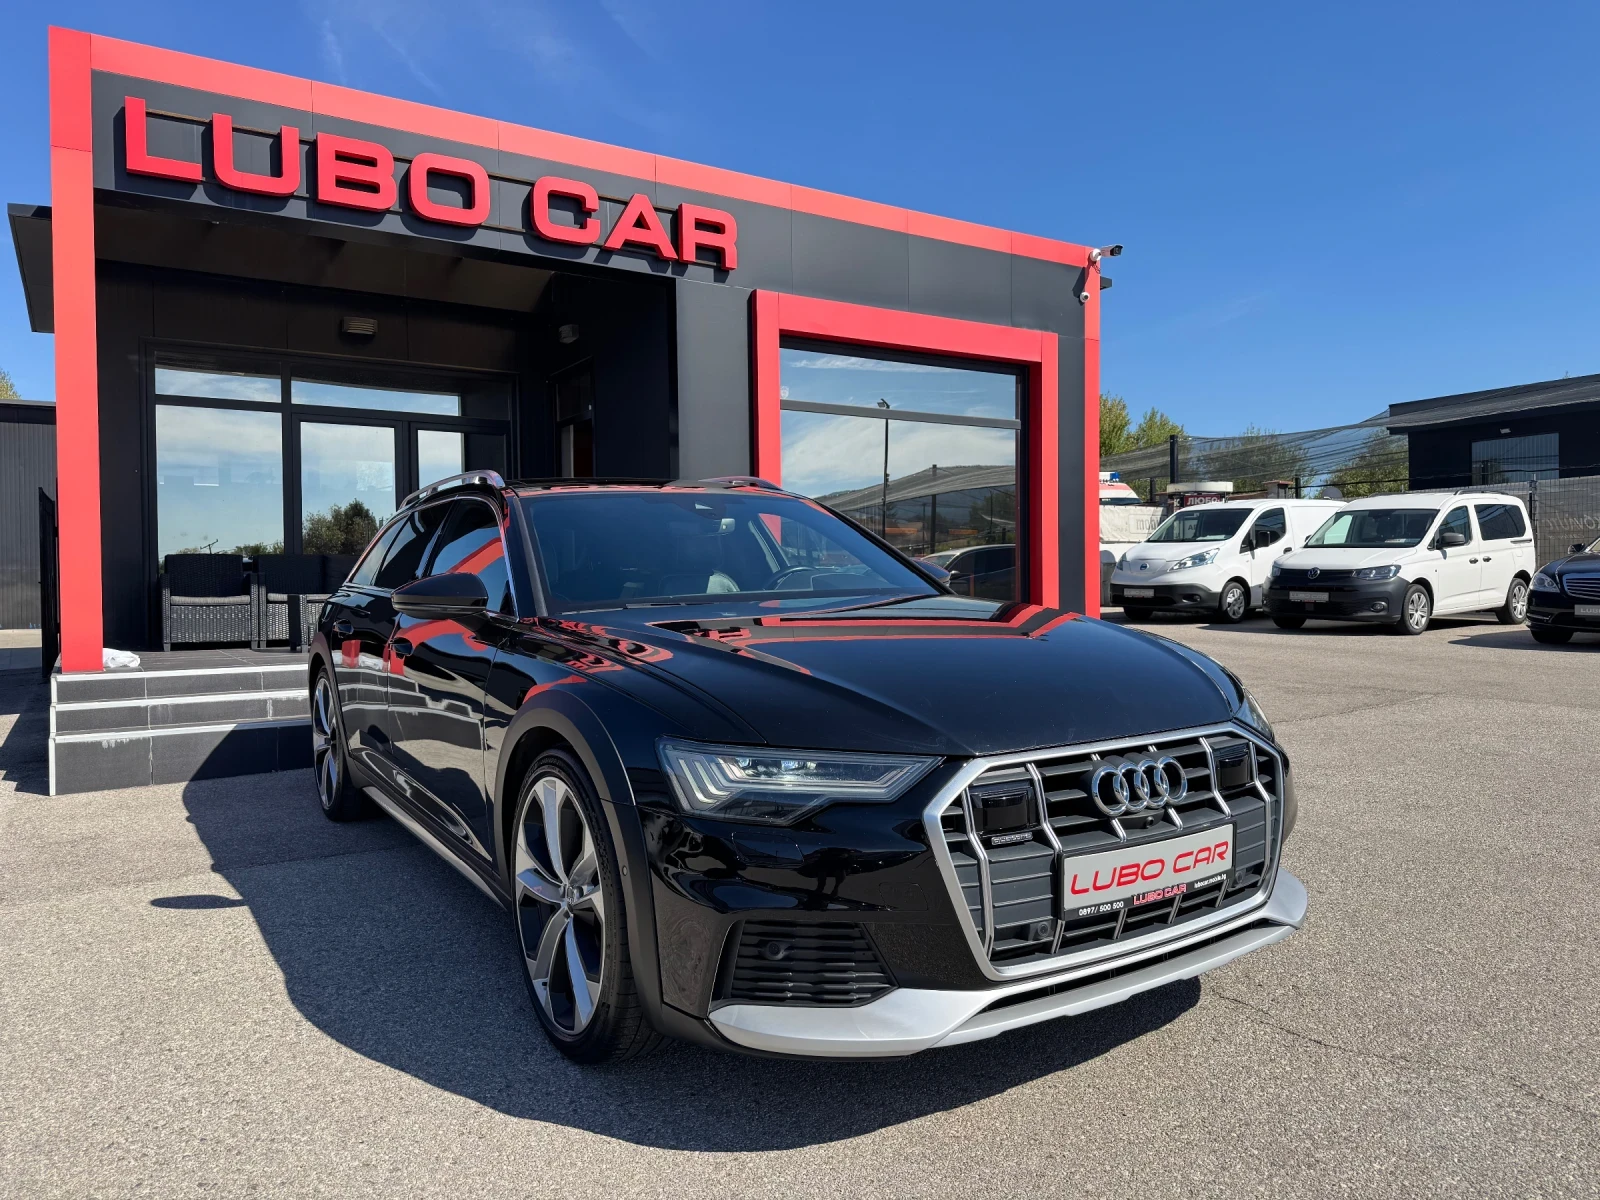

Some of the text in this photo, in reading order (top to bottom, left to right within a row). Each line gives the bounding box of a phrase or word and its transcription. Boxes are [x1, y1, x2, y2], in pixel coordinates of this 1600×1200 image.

[124, 95, 738, 272] LUBO CAR
[1070, 840, 1229, 895] LUBO CAR
[1078, 900, 1125, 916] 0897/ 500 500
[1133, 883, 1187, 906] LUBO CAR
